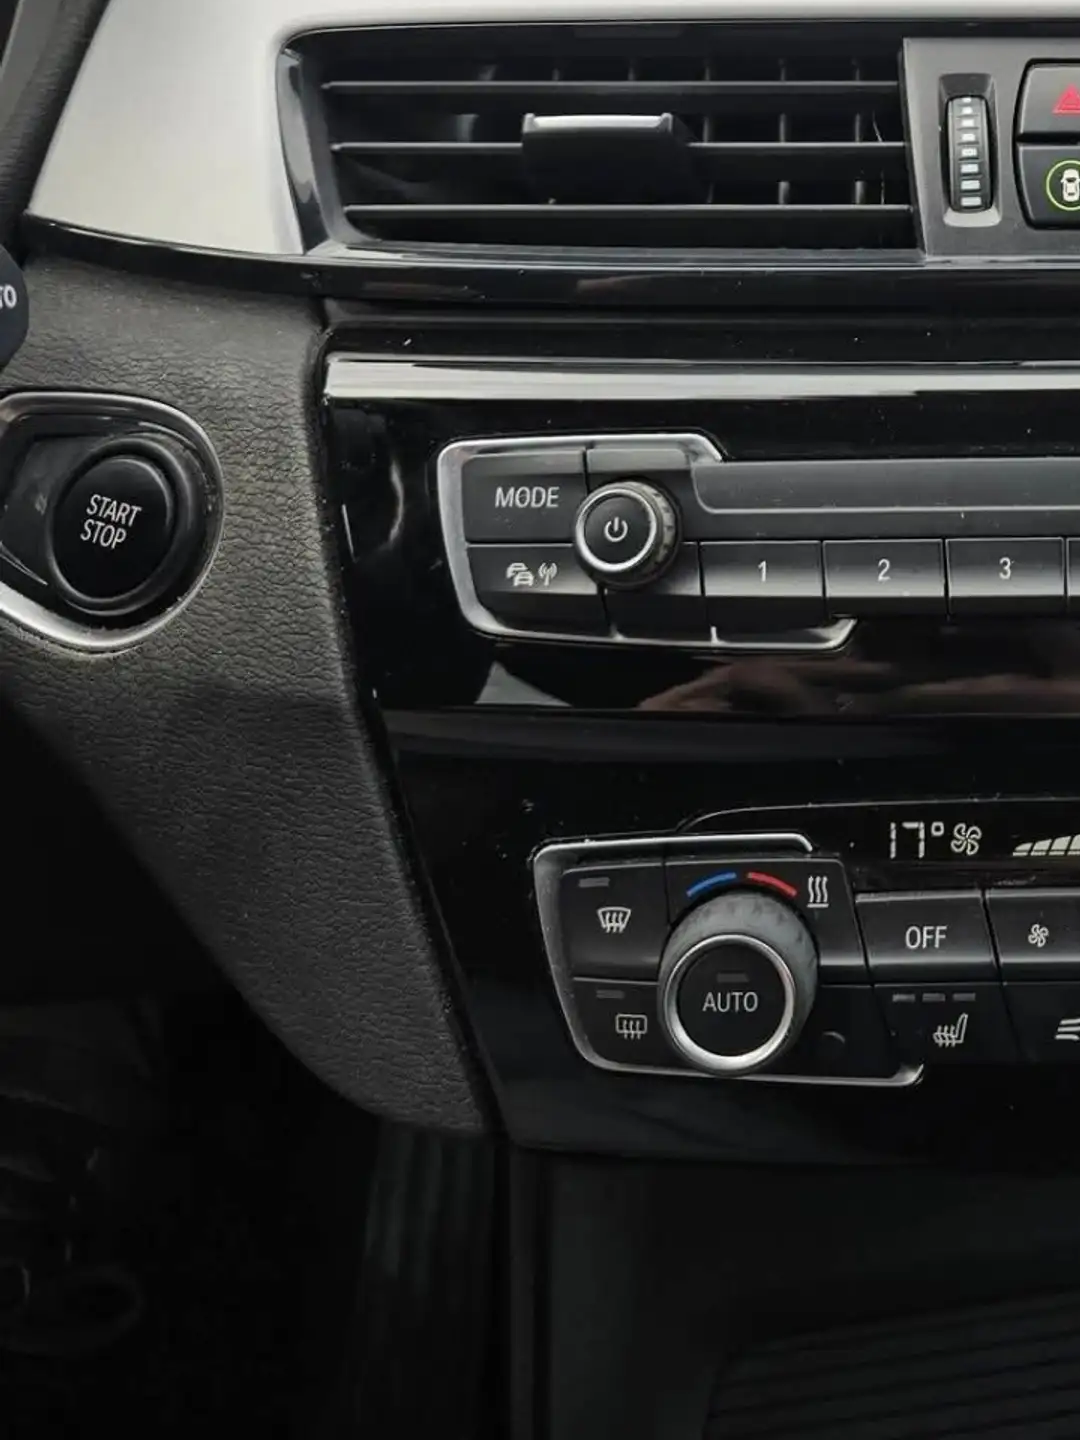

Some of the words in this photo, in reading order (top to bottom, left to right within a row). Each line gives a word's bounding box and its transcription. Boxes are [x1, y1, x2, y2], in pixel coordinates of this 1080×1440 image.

[494, 486, 560, 509] MODE
[86, 493, 142, 527] START
[80, 518, 127, 550] STOP
[757, 562, 768, 582] 1
[876, 559, 892, 581] 2
[997, 557, 1012, 580] 3
[905, 925, 948, 950] OFF
[701, 991, 759, 1014] AUTO
